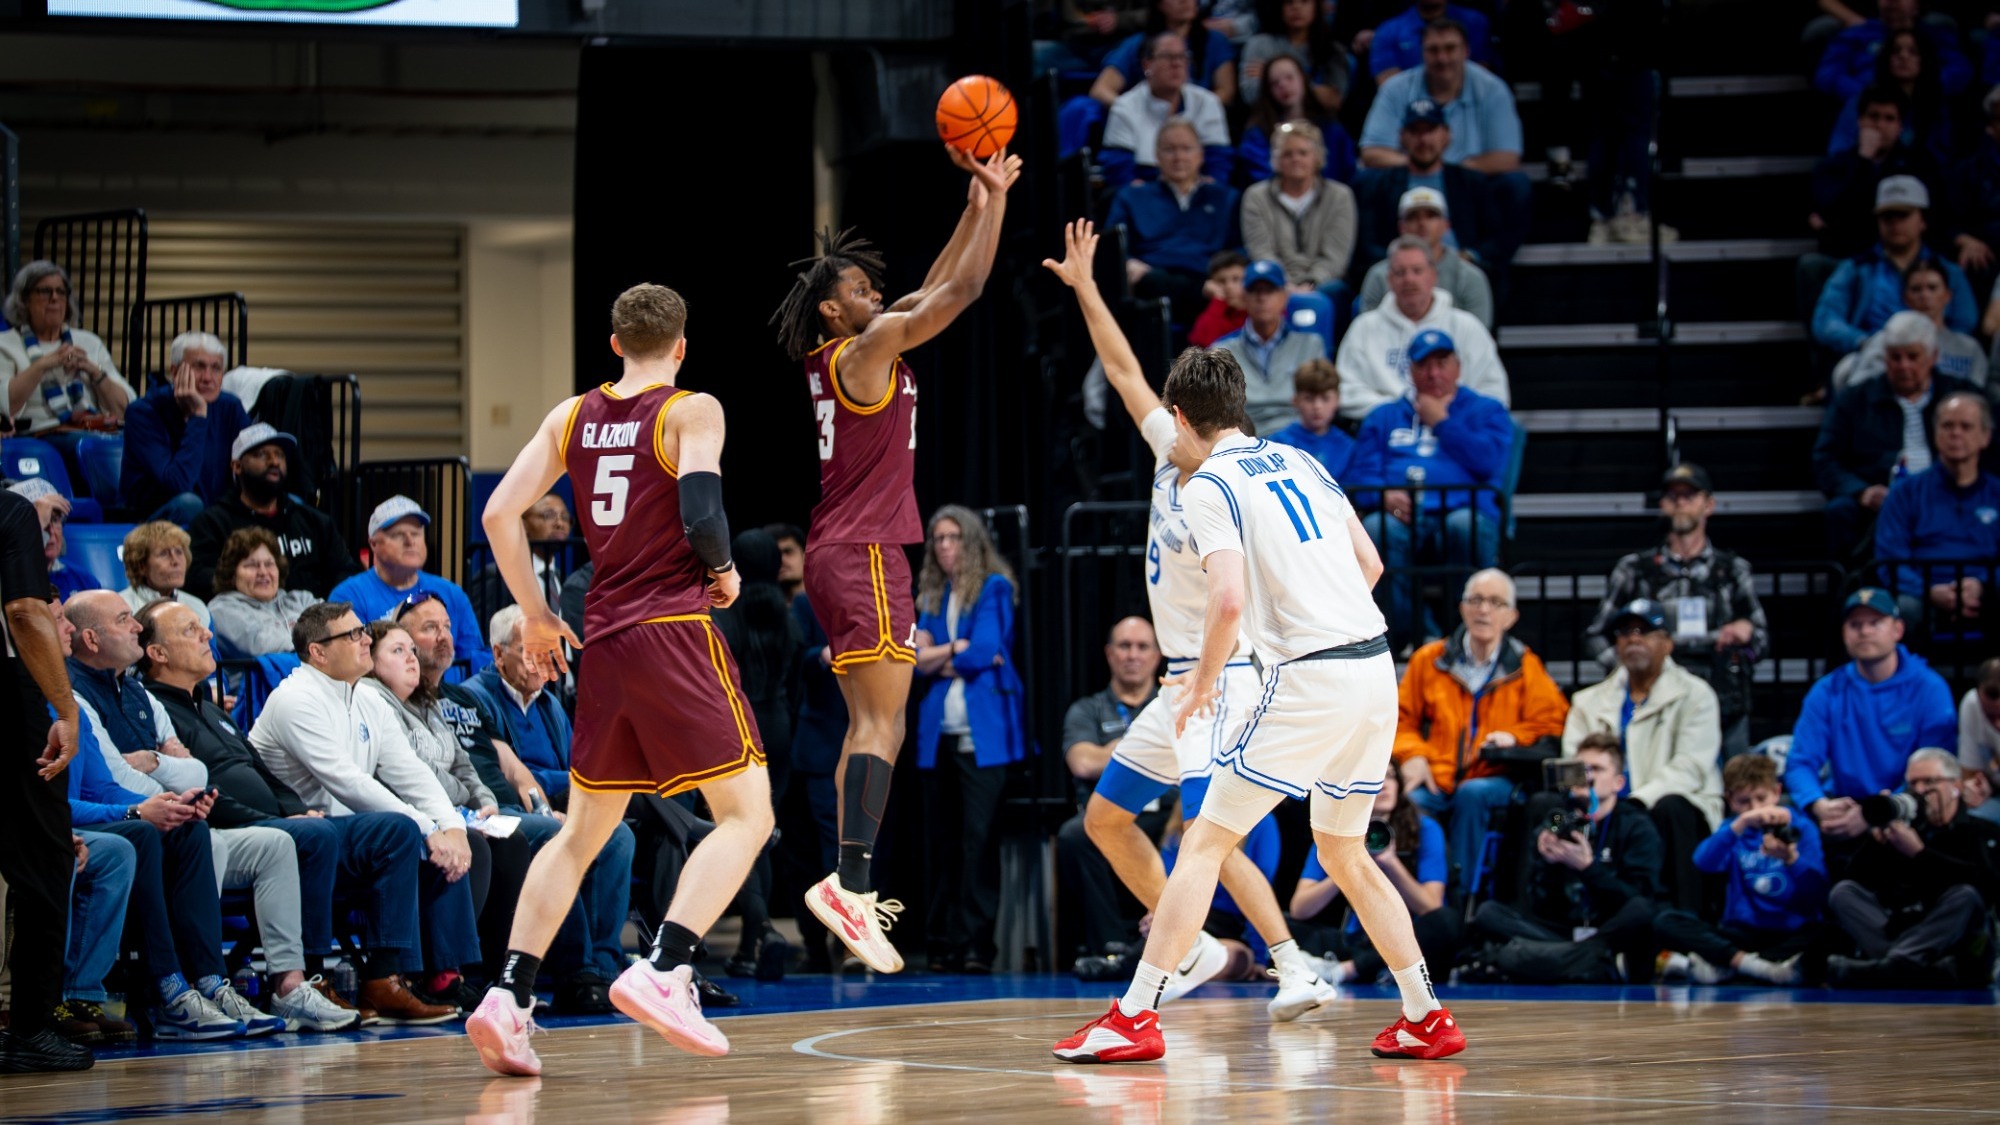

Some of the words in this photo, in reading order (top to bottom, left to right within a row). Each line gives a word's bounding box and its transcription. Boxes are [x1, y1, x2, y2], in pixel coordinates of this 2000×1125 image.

[581, 421, 641, 448] GLAZKOV
[1237, 453, 1288, 477] DUNLAP
[591, 454, 635, 526] 5
[1265, 479, 1323, 543] 11
[1160, 524, 1184, 554] LOUIS
[1149, 538, 1160, 585] 9
